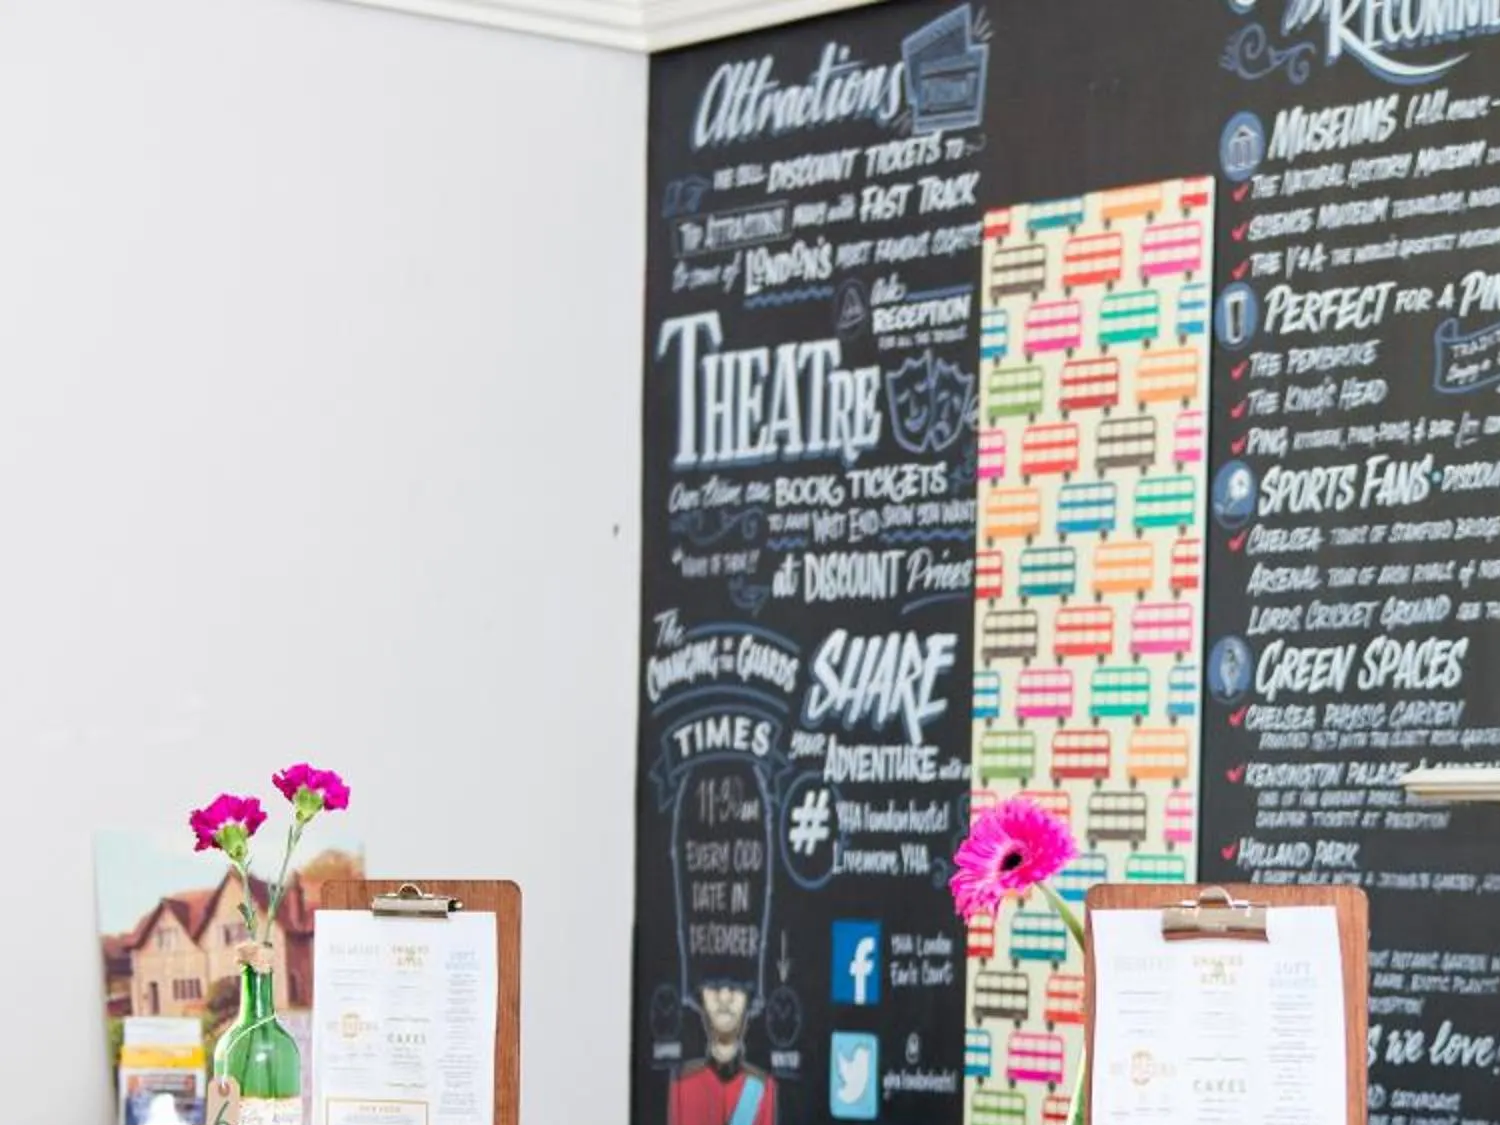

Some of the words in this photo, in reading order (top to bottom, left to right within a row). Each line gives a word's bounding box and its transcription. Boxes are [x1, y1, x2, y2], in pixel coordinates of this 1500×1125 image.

[694, 42, 906, 148] Attractions
[1267, 94, 1400, 163] MUSEUMS
[767, 149, 860, 193] DISCOUNT
[865, 130, 944, 178] TICKETS
[1414, 139, 1488, 178] MUSEUM
[860, 184, 914, 223] FAST
[918, 170, 980, 214] TRACK
[1316, 195, 1390, 230] MUSEUM
[872, 293, 972, 334] RECEPTION
[1264, 281, 1398, 336] PERFECT
[1394, 288, 1431, 313] FOR
[1437, 282, 1455, 309] A
[1249, 351, 1283, 378] THE
[1248, 387, 1280, 417] THE
[1338, 376, 1389, 412] HEAD
[775, 475, 845, 507] BOOK
[846, 461, 948, 502] TICKETS
[1257, 463, 1358, 517] SPORTS
[1359, 452, 1434, 510] FANS
[1246, 523, 1326, 556] CHELSEA
[772, 553, 802, 598] at
[803, 549, 905, 603] DISCOUNT
[906, 547, 974, 593] Prices
[1246, 561, 1323, 598] ARSENAL
[652, 608, 686, 648] The
[1305, 599, 1381, 631] CRICKET
[1380, 593, 1453, 632] GROUND
[647, 636, 718, 703] CHANGING
[736, 634, 800, 694] GUARDS
[807, 628, 959, 746] SHARE
[1256, 638, 1358, 701] GREEN
[1357, 635, 1470, 692] SPACES
[673, 713, 772, 758] TIMES
[1245, 703, 1316, 731] CHELSEA
[1388, 699, 1467, 730] GARDEN
[823, 735, 940, 783] ADVENTURE
[1236, 837, 1312, 871] HOLLAND
[1312, 839, 1360, 871] PARK
[689, 923, 759, 957] DECEMBER
[1385, 1028, 1425, 1065] we
[1192, 1078, 1247, 1095] CAKES
